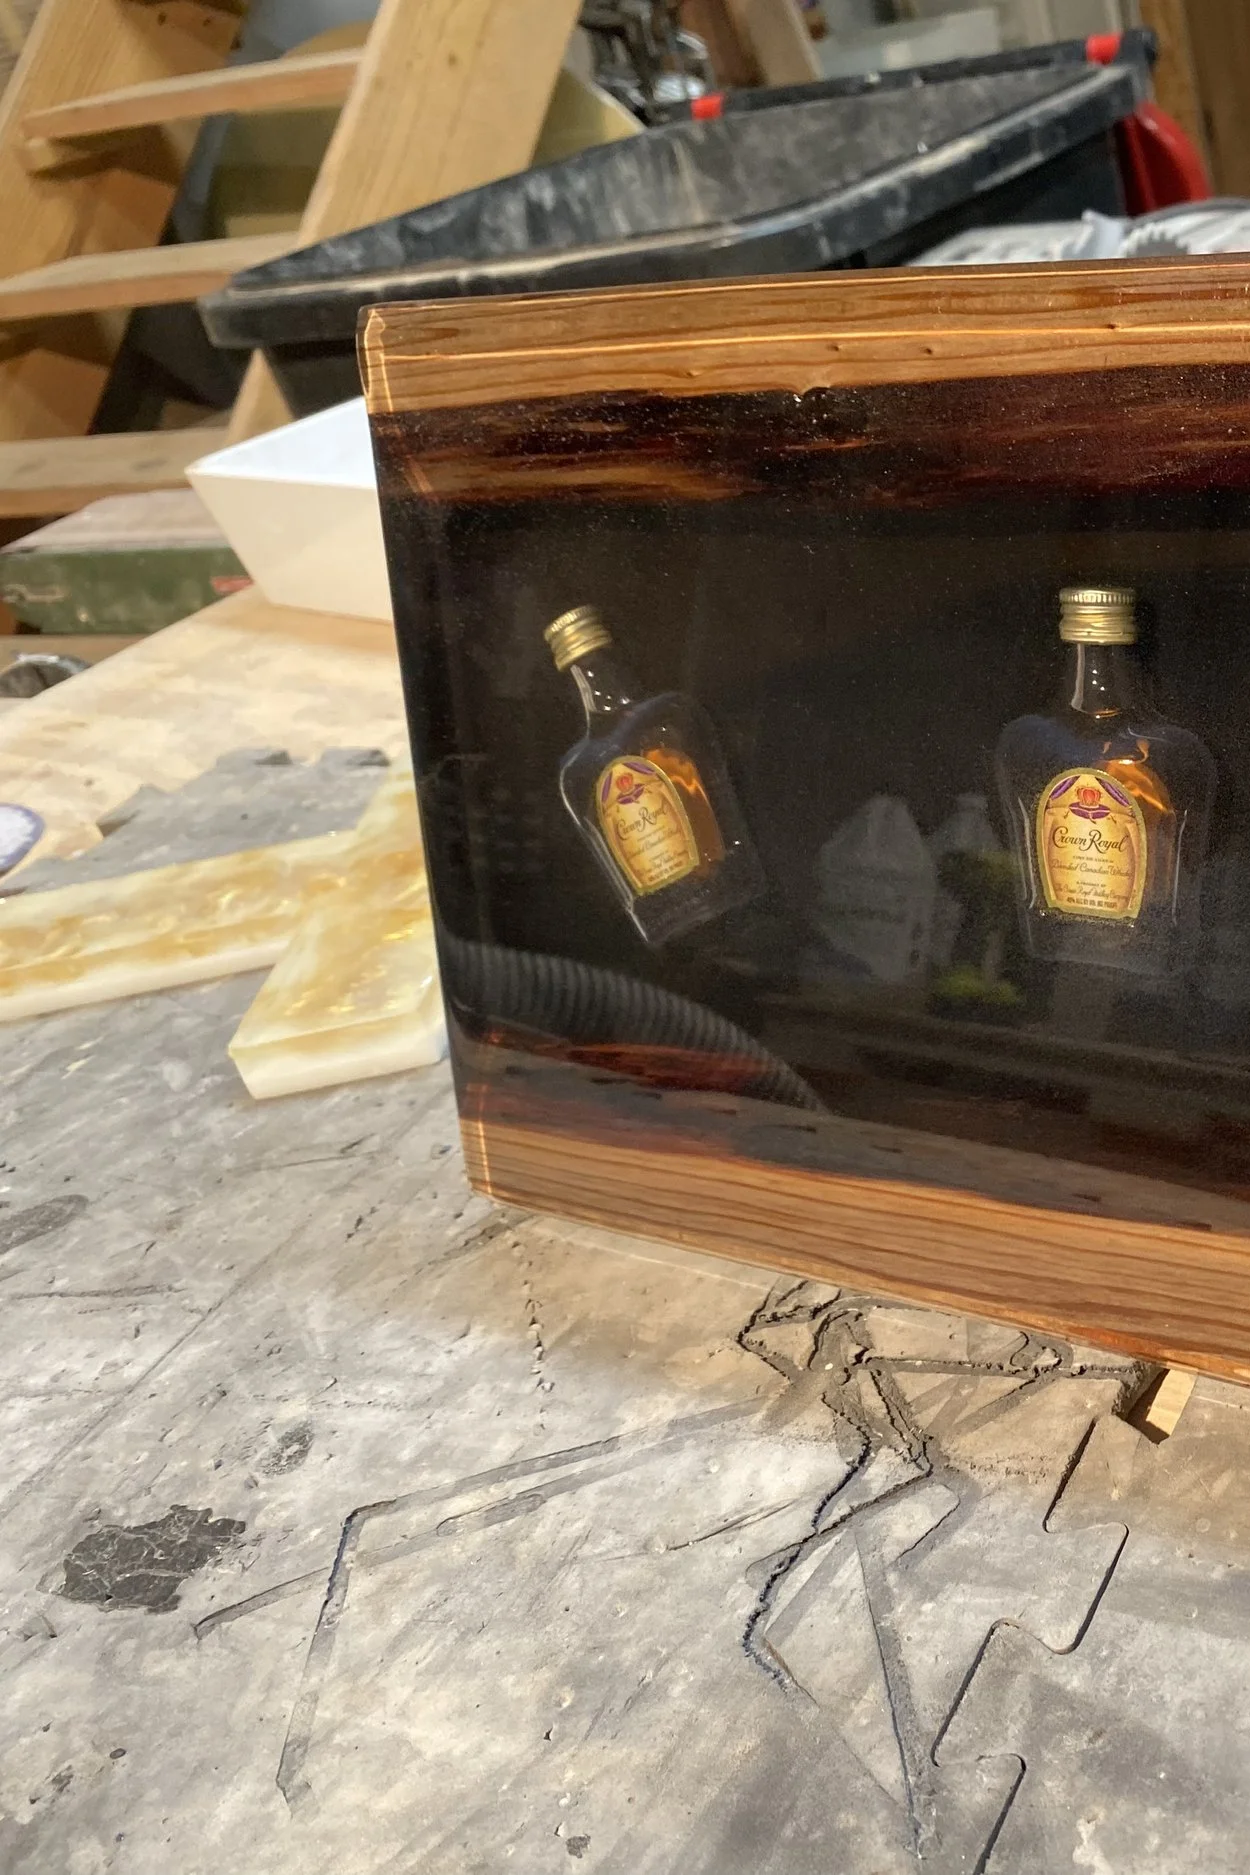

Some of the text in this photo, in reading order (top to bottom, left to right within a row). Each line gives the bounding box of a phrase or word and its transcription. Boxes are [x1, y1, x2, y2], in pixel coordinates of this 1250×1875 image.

[617, 819, 642, 841] Crown
[637, 802, 666, 832] Royal
[1052, 825, 1129, 854] Crown Royal
